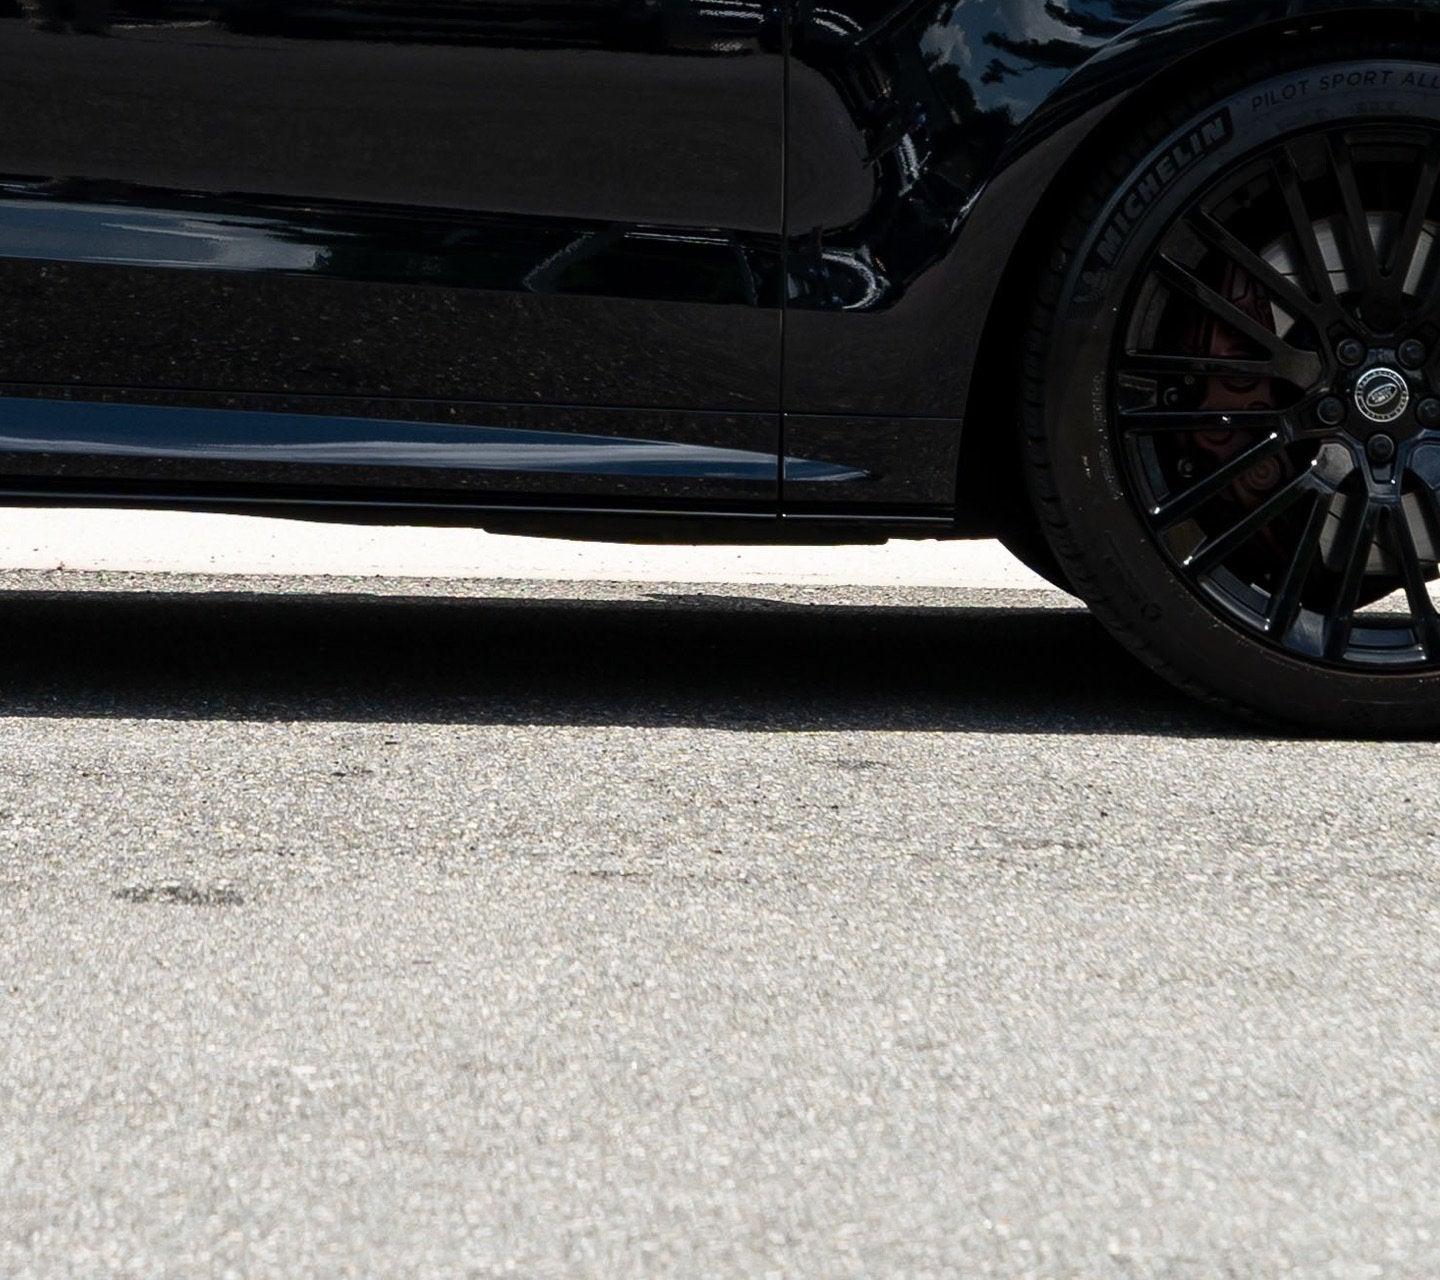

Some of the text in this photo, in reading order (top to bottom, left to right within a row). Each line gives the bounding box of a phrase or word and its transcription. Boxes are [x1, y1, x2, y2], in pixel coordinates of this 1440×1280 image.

[1251, 79, 1309, 111] PILOT
[1319, 70, 1393, 91] SPORT
[1095, 116, 1226, 266] MICHELIN
